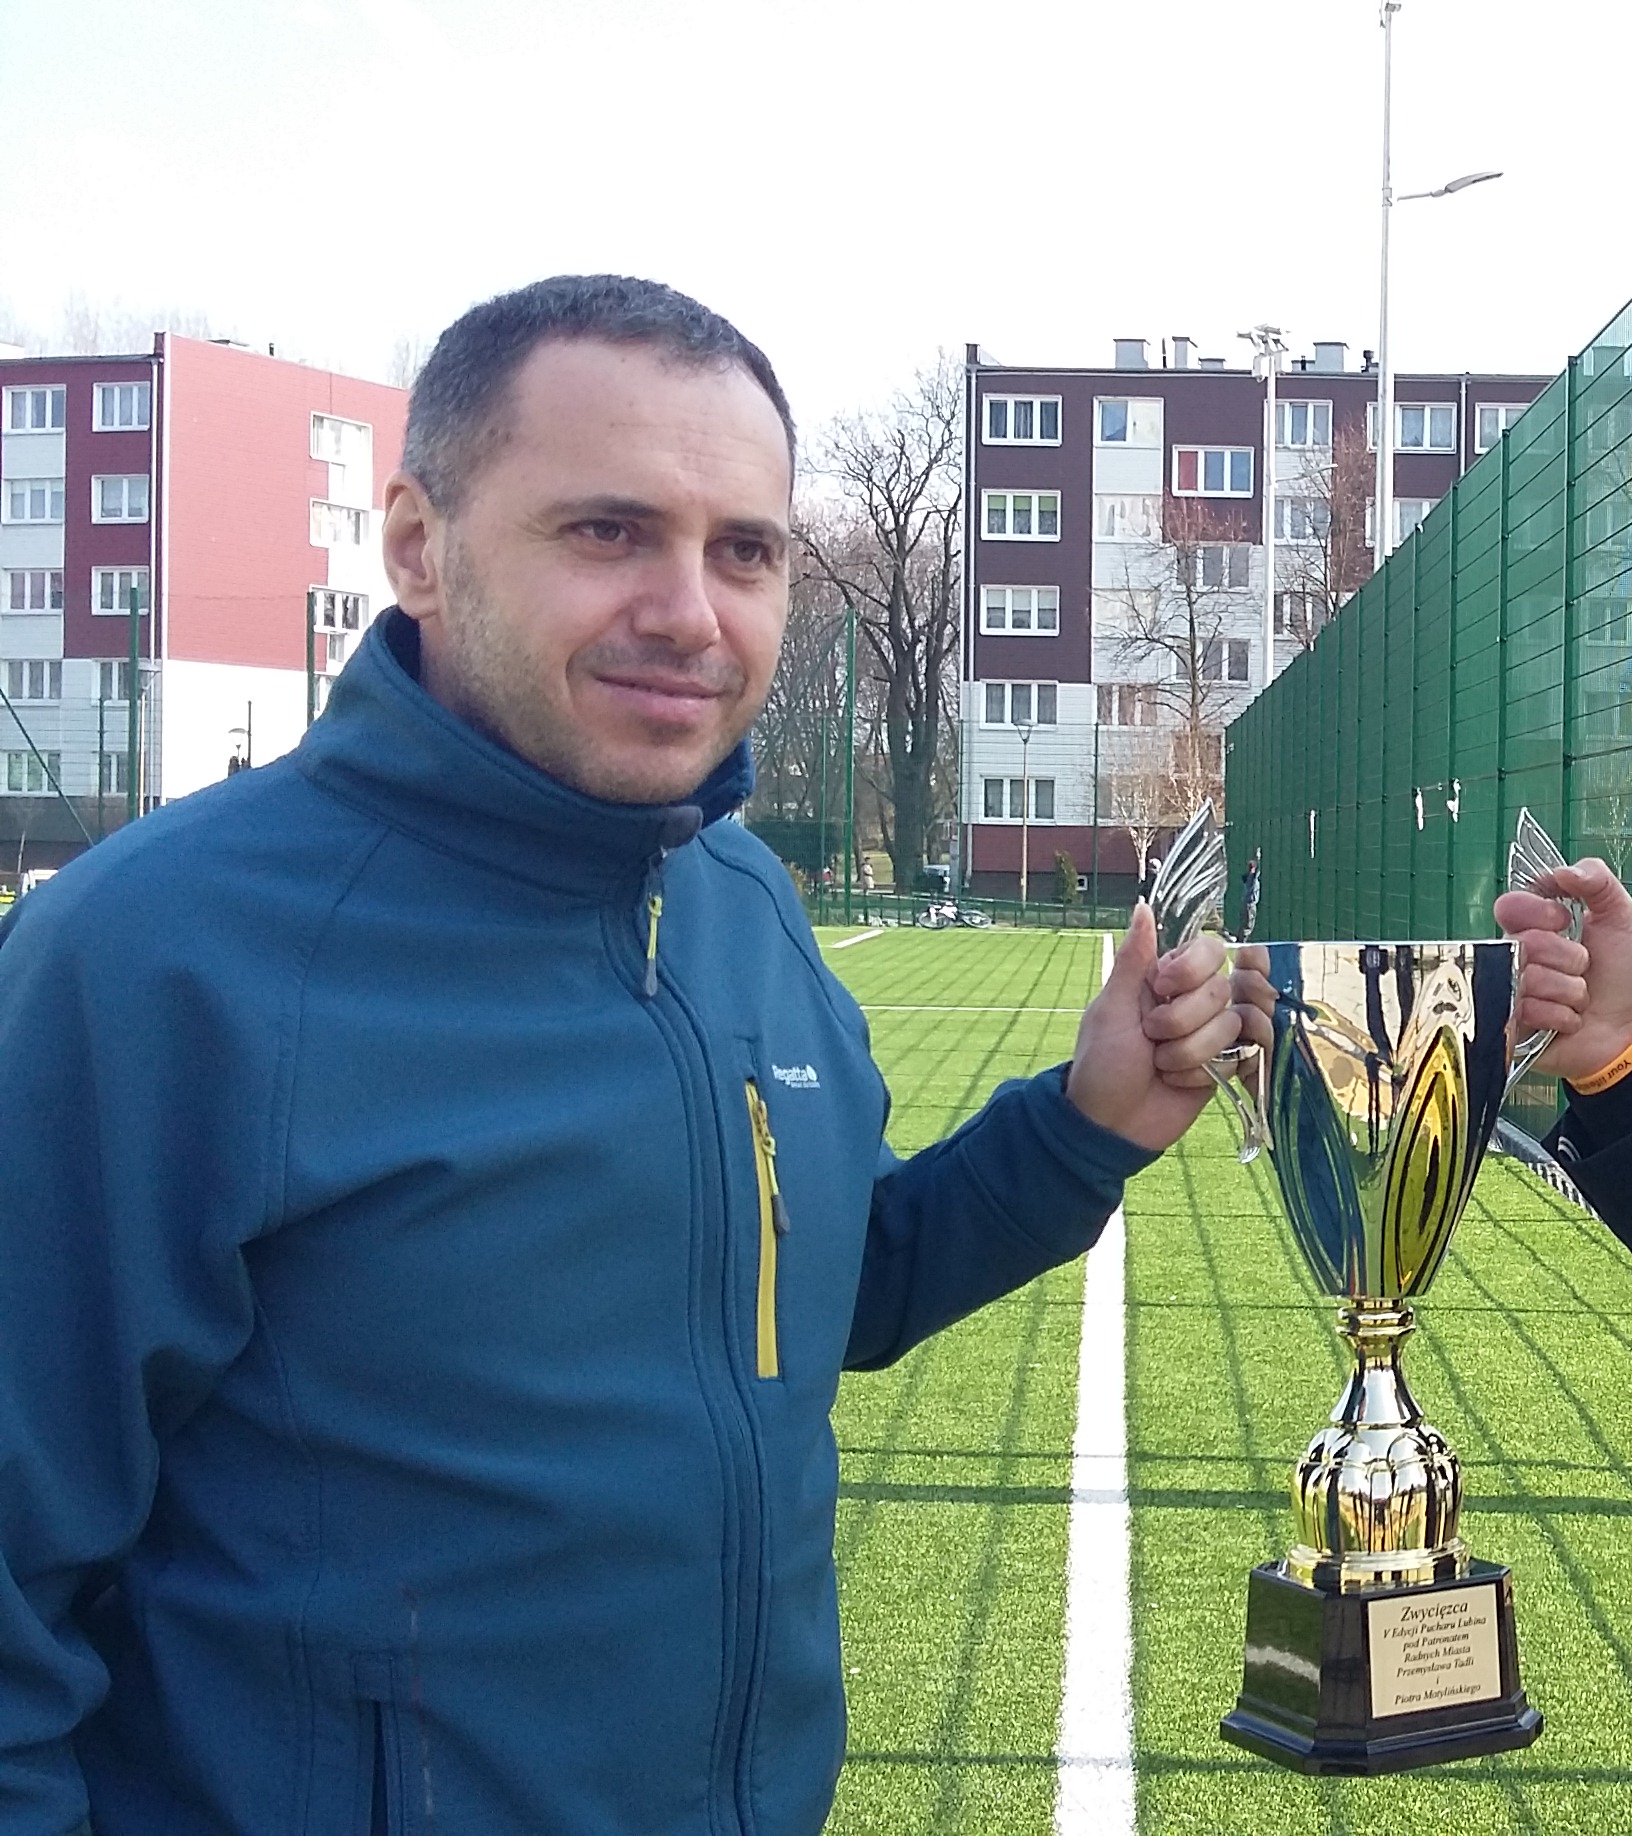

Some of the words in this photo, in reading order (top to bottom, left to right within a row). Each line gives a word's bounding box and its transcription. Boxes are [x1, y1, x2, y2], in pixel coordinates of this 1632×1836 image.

[771, 1064, 808, 1086] Regatta
[1607, 1059, 1632, 1079] Your
[1400, 1602, 1468, 1623] Zwycięzca
[1383, 1629, 1391, 1639] V
[1392, 1626, 1419, 1638] Edycji
[1420, 1623, 1456, 1634] Pucharu
[1457, 1616, 1487, 1628] Lubina
[1403, 1639, 1420, 1652] pod
[1421, 1633, 1469, 1646] Patronatem
[1404, 1650, 1440, 1663] Radnych
[1442, 1646, 1471, 1656] Miasta
[1394, 1694, 1421, 1705] Piotra
[1423, 1683, 1481, 1700] Motylińskiego
